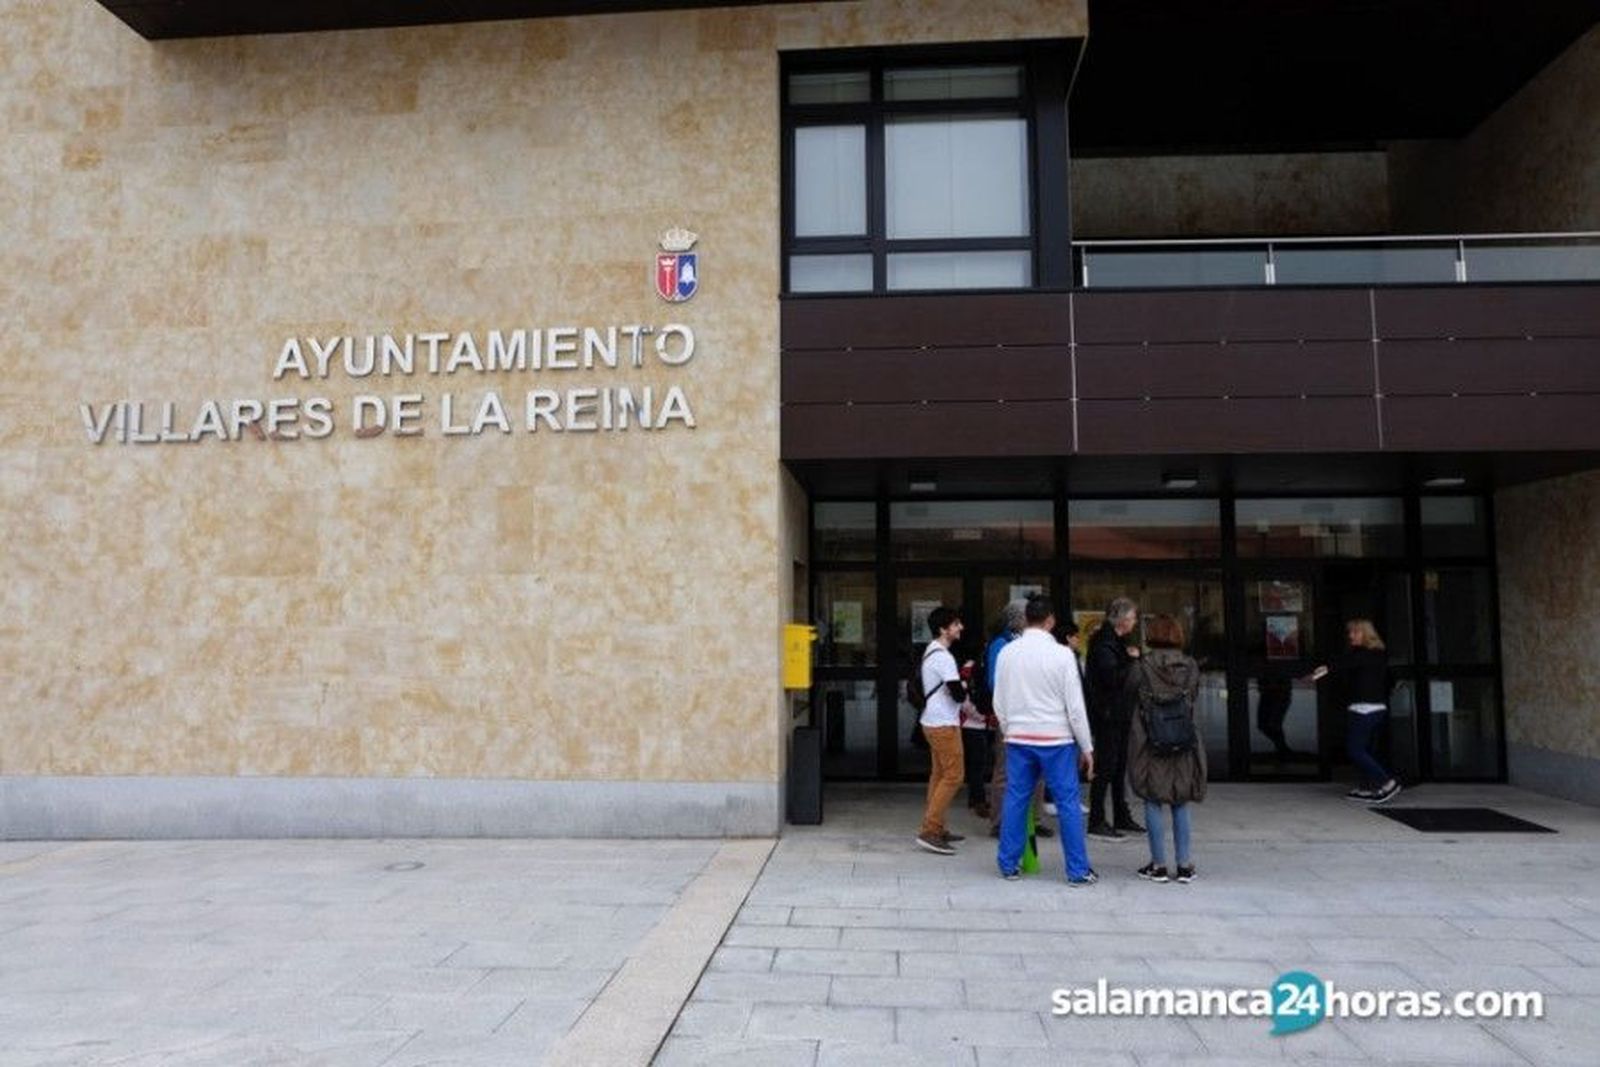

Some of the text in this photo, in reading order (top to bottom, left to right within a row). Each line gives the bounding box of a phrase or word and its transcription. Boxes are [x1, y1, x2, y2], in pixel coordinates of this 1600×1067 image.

[273, 323, 696, 379] AYUNTAMIENTO
[80, 387, 696, 443] VILLARES DE LA REINA
